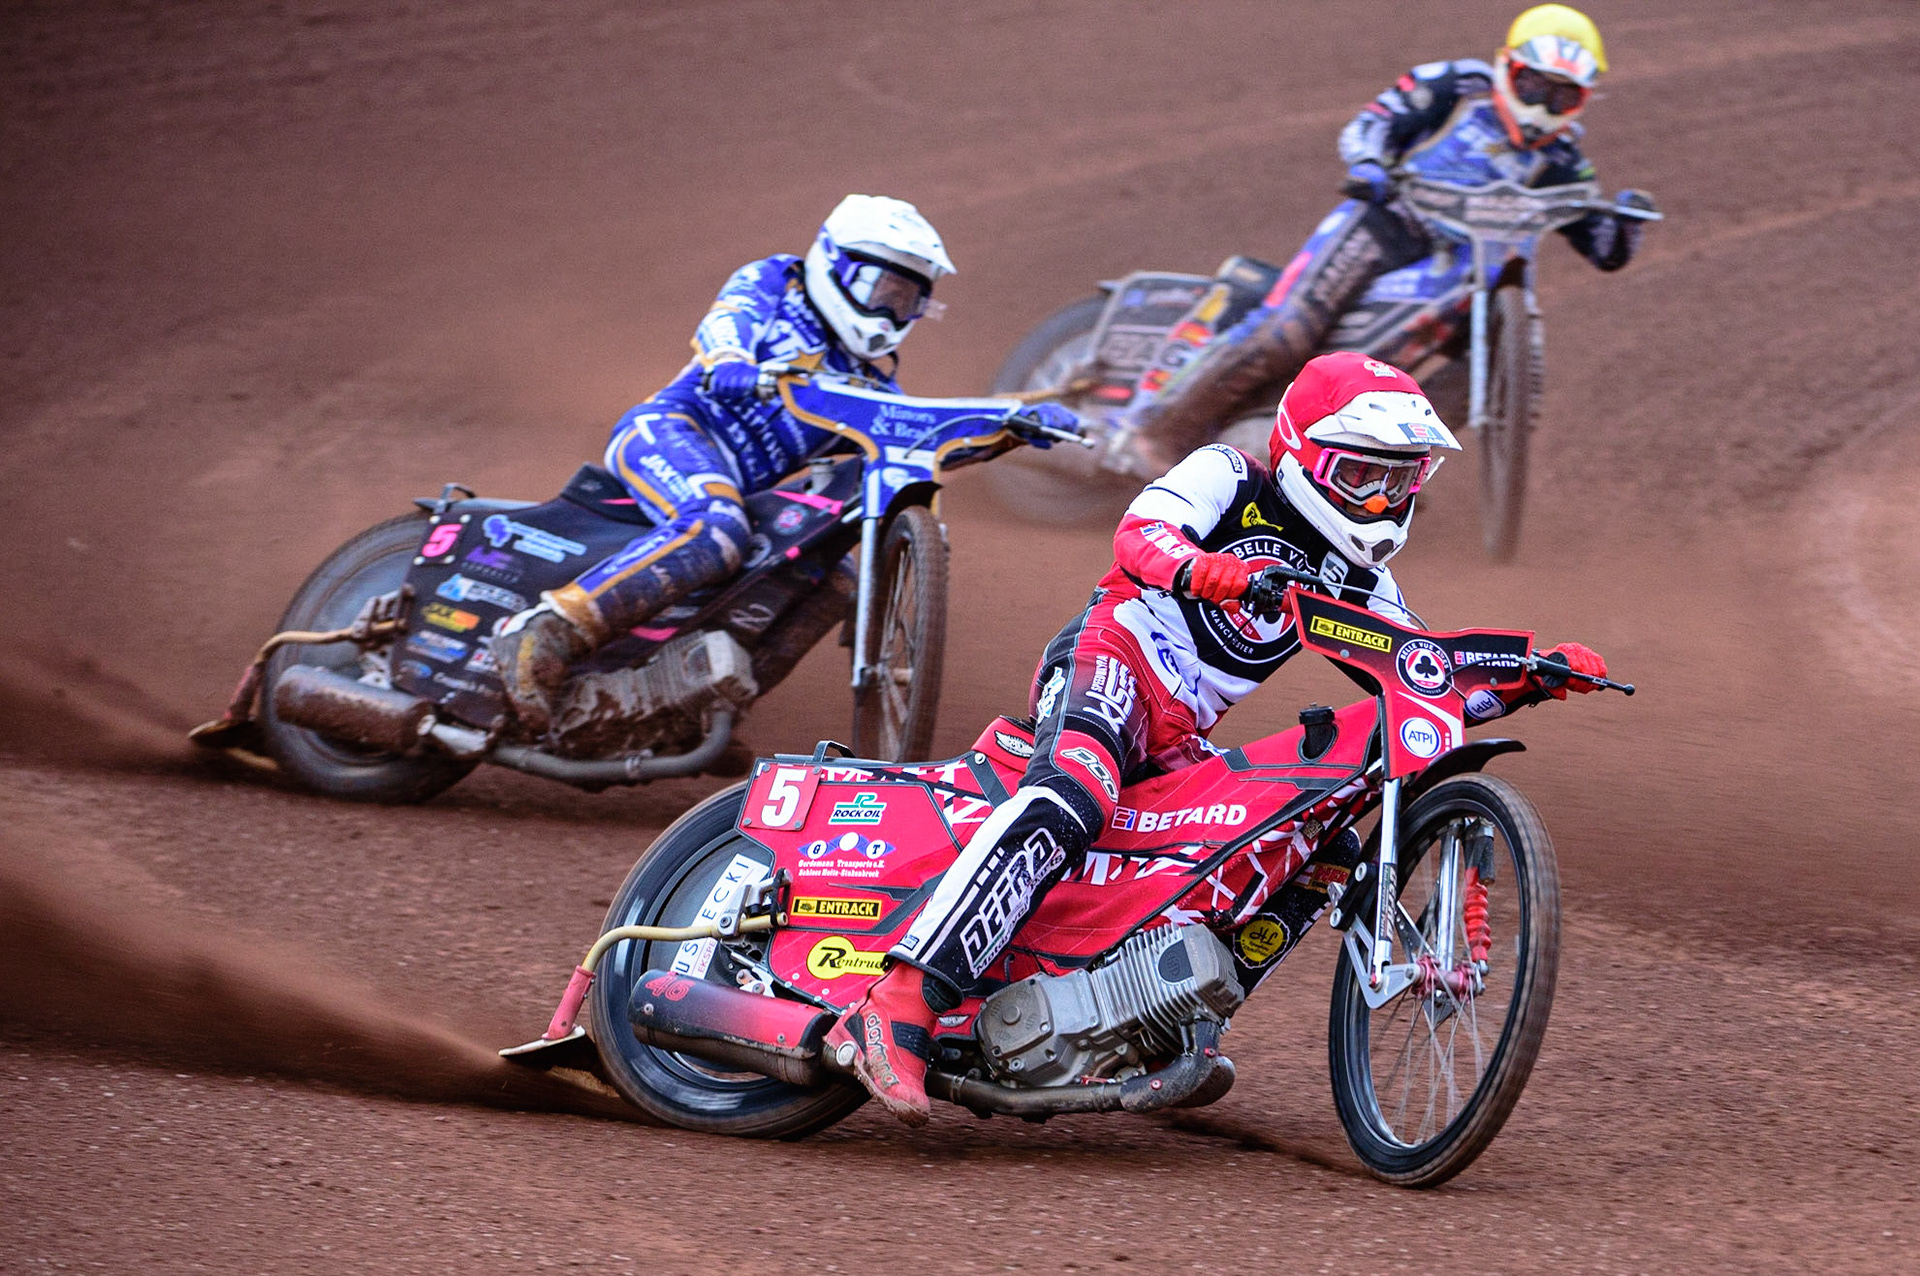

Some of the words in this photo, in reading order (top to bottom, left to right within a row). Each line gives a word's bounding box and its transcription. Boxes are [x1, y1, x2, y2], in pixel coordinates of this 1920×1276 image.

[422, 524, 462, 557] 5
[1233, 541, 1281, 558] BELLE
[1336, 625, 1386, 648] ENTRACK
[1400, 643, 1417, 660] BELLE
[1419, 642, 1434, 651] VUE
[1465, 652, 1520, 667] BETARD
[1472, 697, 1495, 714] ATPI
[1408, 730, 1433, 745] ATPI
[761, 768, 807, 827] 5
[833, 809, 863, 818] ROCK
[864, 810, 880, 818] OIL
[1137, 804, 1247, 832] BETARD
[872, 844, 881, 855] T
[819, 901, 874, 916] ENTRACK
[817, 946, 884, 969] Rentruc
[645, 971, 695, 1001] 46
